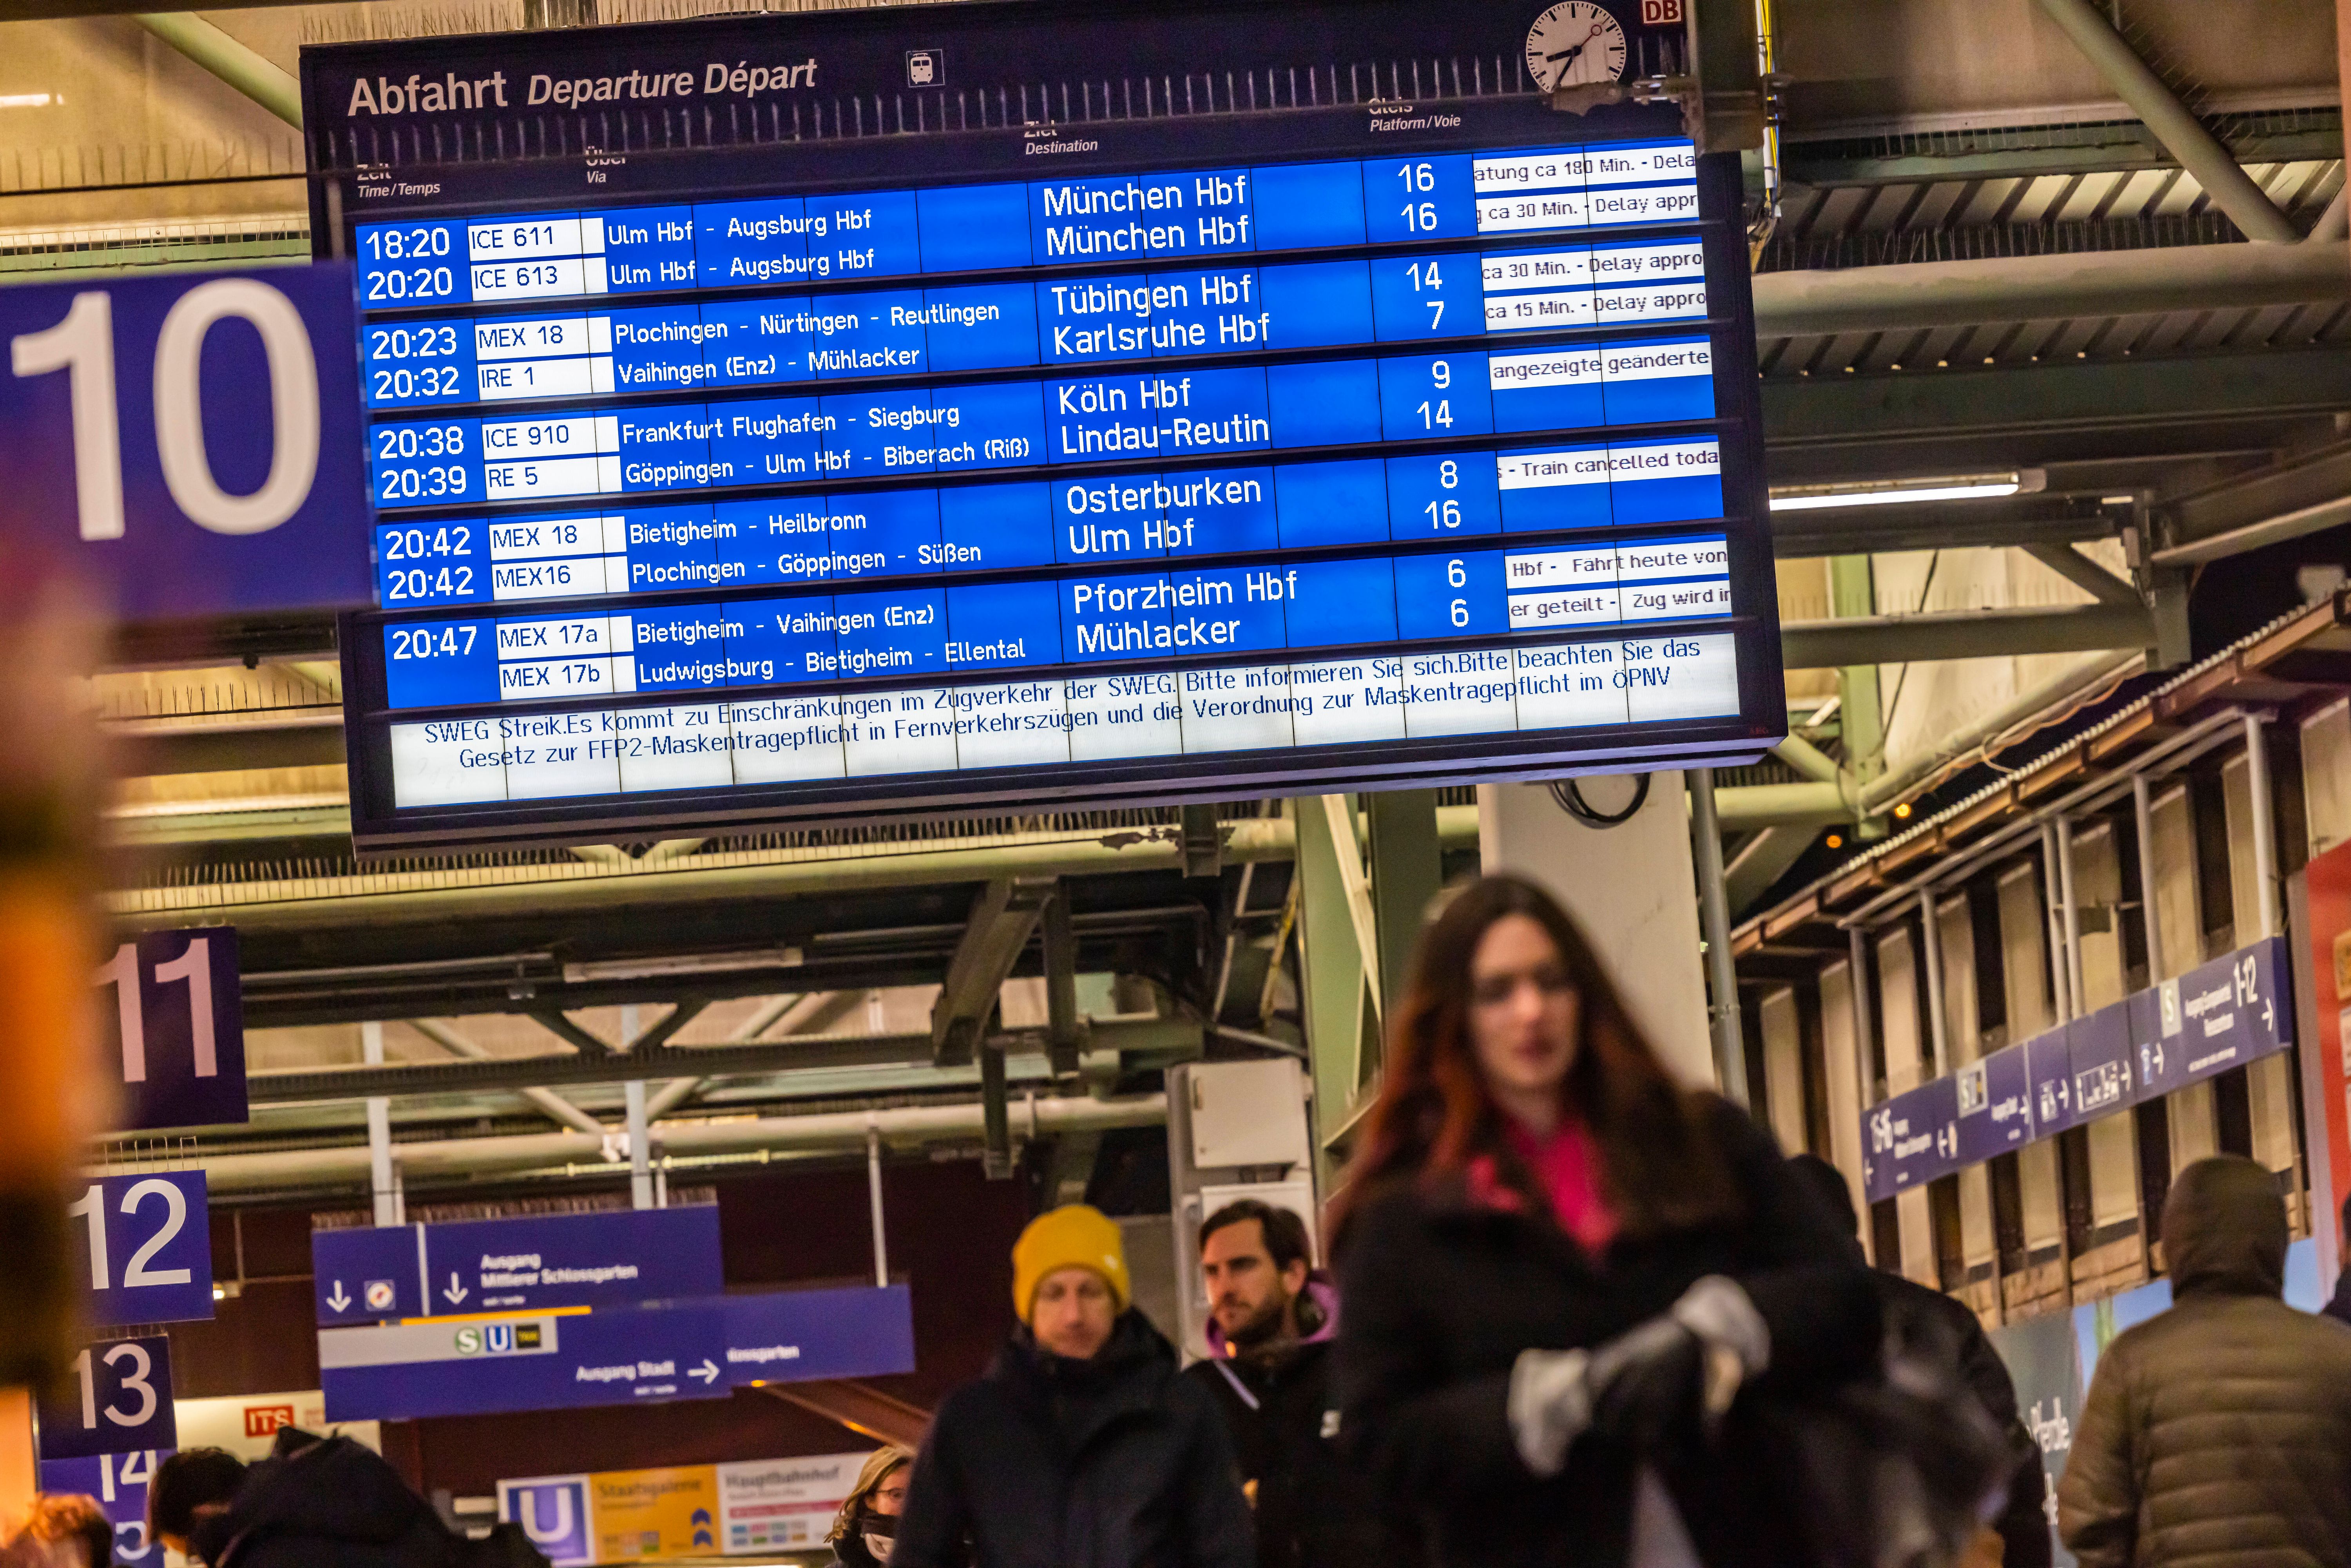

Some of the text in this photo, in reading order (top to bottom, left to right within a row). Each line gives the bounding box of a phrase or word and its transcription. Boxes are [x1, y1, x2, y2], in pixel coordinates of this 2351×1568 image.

[1646, 0, 1679, 21] DB
[348, 58, 817, 116] Abfahrt Departure Départ
[1025, 139, 1098, 155] Destination
[587, 171, 606, 183] Via
[1398, 163, 1434, 192] 16
[1599, 158, 1634, 172] Min.
[1043, 175, 1246, 216] München Hbf
[1595, 197, 1648, 213] Delay
[608, 208, 871, 244] Ulm Hbf Augsburg Hbf
[1401, 202, 1437, 232] 16
[366, 227, 450, 259] 18:20
[471, 226, 552, 249] ICE 611
[1046, 214, 1248, 255] München Hbf
[474, 265, 558, 289] ICE 613
[611, 248, 874, 284] Ulm Hbf Augsburg Hbf
[1406, 261, 1442, 291] 14
[1482, 257, 1643, 279] ca 30 Min. Delay
[367, 266, 453, 300] 20:20
[1051, 274, 1251, 317] Tübingen Hbf
[615, 303, 999, 344] Plochingen Nürtingen Reutlingen
[1426, 300, 1444, 330] 7
[371, 326, 456, 360] 20:23
[478, 325, 563, 348] MEX 18
[1054, 312, 1270, 355] Karlsruhe Hbf
[481, 366, 533, 388] IRE 1
[618, 346, 920, 385] Vaihingen (Enz) Mühlacker
[1432, 360, 1450, 389] 9
[1494, 350, 1710, 380] angezeigte geänderte
[374, 366, 460, 399] 20:32
[1059, 378, 1191, 415] Köln Hbf
[12, 278, 320, 540] 10
[622, 405, 960, 444] Frankfurt Flughafen Siegburg
[1416, 399, 1453, 429] 14
[379, 425, 464, 459] 20:38
[485, 424, 569, 448] ICE 910
[1061, 413, 1269, 454] Lindau-Reutin
[488, 466, 538, 487] RE 5
[625, 437, 1029, 487] Göppingen Ulm Hbf Biberach (Riß)
[1440, 460, 1458, 489] 8
[1521, 453, 1669, 476] Train cancelled
[381, 465, 466, 499] 20:39
[1067, 476, 1261, 514] Osterburken
[630, 512, 866, 546] Bietigheim Heilbronn
[1424, 500, 1461, 529] 16
[385, 526, 471, 560] 20:42
[493, 525, 577, 548] MEX 18
[1069, 517, 1194, 554] Ulm Hbf
[495, 565, 571, 588] MEX16
[632, 543, 981, 583] Plochingen Göppingen Süßen
[1447, 559, 1466, 587] 6
[1512, 561, 1543, 576] Hbf
[1630, 552, 1688, 568] heute
[1693, 551, 1726, 563] von
[388, 566, 474, 599] 20:42
[1074, 570, 1297, 613] Pforzheim Hbf
[1451, 598, 1469, 627] 6
[1537, 588, 1714, 618] geteilt Zug wird
[500, 624, 597, 648] MEX 17a
[637, 604, 934, 645] Bietigheim Vaihingen (Enz)
[1077, 617, 1240, 653] Mühlacker
[392, 625, 477, 659] 20:47
[502, 664, 600, 688] MEX 17b
[639, 637, 1025, 684] Ludwigsburg Bietigheim Ellental
[424, 721, 489, 743] SWEG
[601, 708, 674, 731] kommt
[685, 711, 708, 726] zu
[718, 698, 891, 723] Einschränkungen
[933, 683, 1052, 712] Zugverkehr
[1065, 681, 1097, 700] der
[1186, 671, 1235, 692] Bitte
[1245, 666, 1362, 687] informieren
[1372, 660, 1400, 678] Sie
[1517, 646, 1612, 668] beachten
[1622, 643, 1652, 660] Sie
[1663, 640, 1700, 657] das
[459, 666, 1670, 768] Gesetz zur FFP2-Maskentragepflicht in Fernverkehrszügen und die Verordnung zur Maskentragepflicht ÖPNV
[91, 938, 217, 1082] 11
[69, 1179, 191, 1289] 12
[458, 1329, 478, 1354] S
[488, 1327, 509, 1352] U
[74, 1343, 156, 1429] 13
[520, 1488, 573, 1543] U
